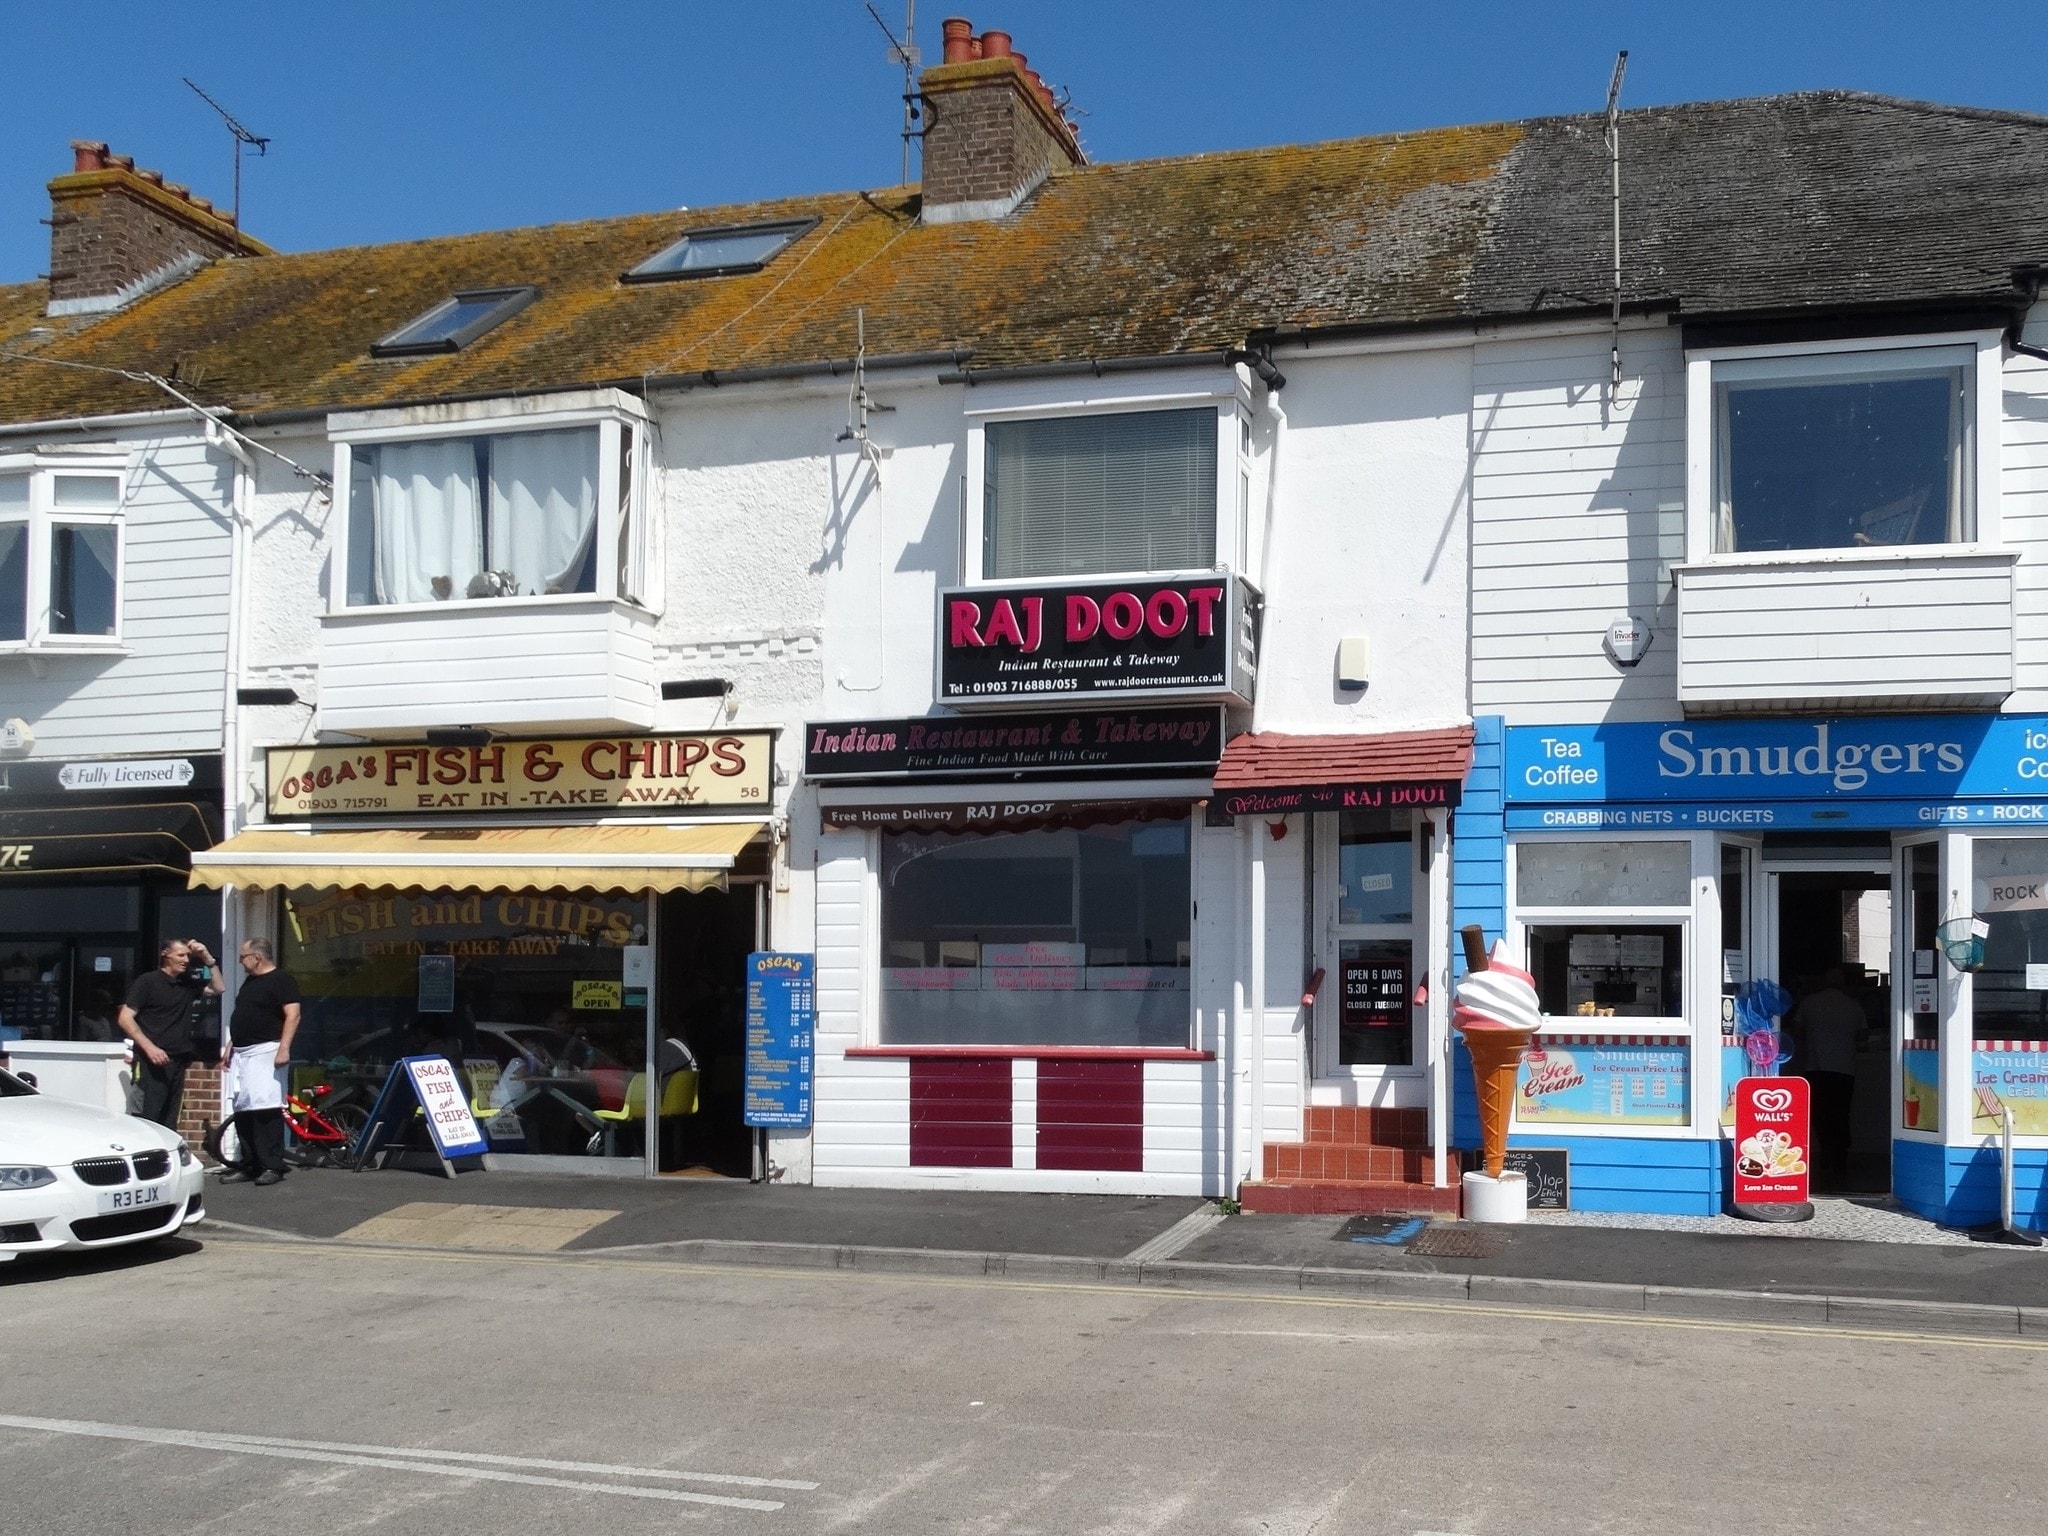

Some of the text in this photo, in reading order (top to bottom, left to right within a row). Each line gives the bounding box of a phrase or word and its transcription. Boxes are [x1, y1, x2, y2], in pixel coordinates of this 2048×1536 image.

[951, 587, 1223, 653] RAJ DOOT
[999, 653, 1180, 672] Indian Restaurant & Takeway
[949, 682, 963, 694] Tel
[973, 682, 1007, 693] 01903
[1011, 679, 1078, 692] 716888/055
[1094, 673, 1224, 688] www.rajdootrestaurant.co.uk
[810, 715, 1212, 755] Indian Restaurant & Takeway
[1541, 738, 1582, 759] Tea
[907, 750, 1108, 767] Fine Indian Food Made With Care
[1659, 724, 1964, 791] Smudgers
[77, 765, 174, 786] Fully Licensed
[282, 736, 746, 799] OSCA'S FISH & CHIPS
[1525, 764, 1598, 786] Coffee
[417, 793, 470, 808] EAT
[481, 792, 508, 806] IN
[617, 786, 700, 802] AWAY
[740, 787, 760, 798] 58
[1226, 793, 1303, 815] Welcome
[1343, 789, 1381, 807] RAJ
[1391, 784, 1449, 804] DOOT
[298, 797, 388, 810] 01903 715791
[966, 804, 996, 819] RAJ
[1003, 802, 1055, 816] DOOT
[831, 808, 953, 823] Free Home Delivery
[1543, 809, 1774, 826] CRABBING NETS BUCKETS
[1918, 803, 2044, 821] GIFTS ROCK
[1363, 877, 1391, 889] CLOSED
[1993, 884, 2038, 901] ROCK
[300, 895, 634, 945] FISH and CHIPS
[362, 940, 398, 955] EAT
[406, 940, 426, 955] IN
[446, 940, 499, 955] TAKE
[506, 940, 560, 955] AWAY
[757, 956, 802, 971] OSCA'S
[1347, 969, 1403, 980] OPEN 6 DAYS
[1347, 984, 1368, 994] 5.30
[583, 999, 610, 1008] OPEN
[1347, 1001, 1403, 1009] CLOSED TUESDAY
[1541, 1061, 1573, 1081] Ice
[1609, 1065, 1640, 1073] Cream
[1643, 1065, 1668, 1073] Price
[1670, 1065, 1688, 1073] List
[1522, 1074, 1585, 1097] Cream
[1975, 1071, 1998, 1084] Ice
[427, 1081, 454, 1095] FISH
[439, 1097, 455, 1111] and
[434, 1109, 470, 1124] CHIPS
[1754, 1112, 1790, 1122] WALL'S
[1504, 1152, 1533, 1160] AUCES
[113, 1186, 159, 1208] R3 EJX
